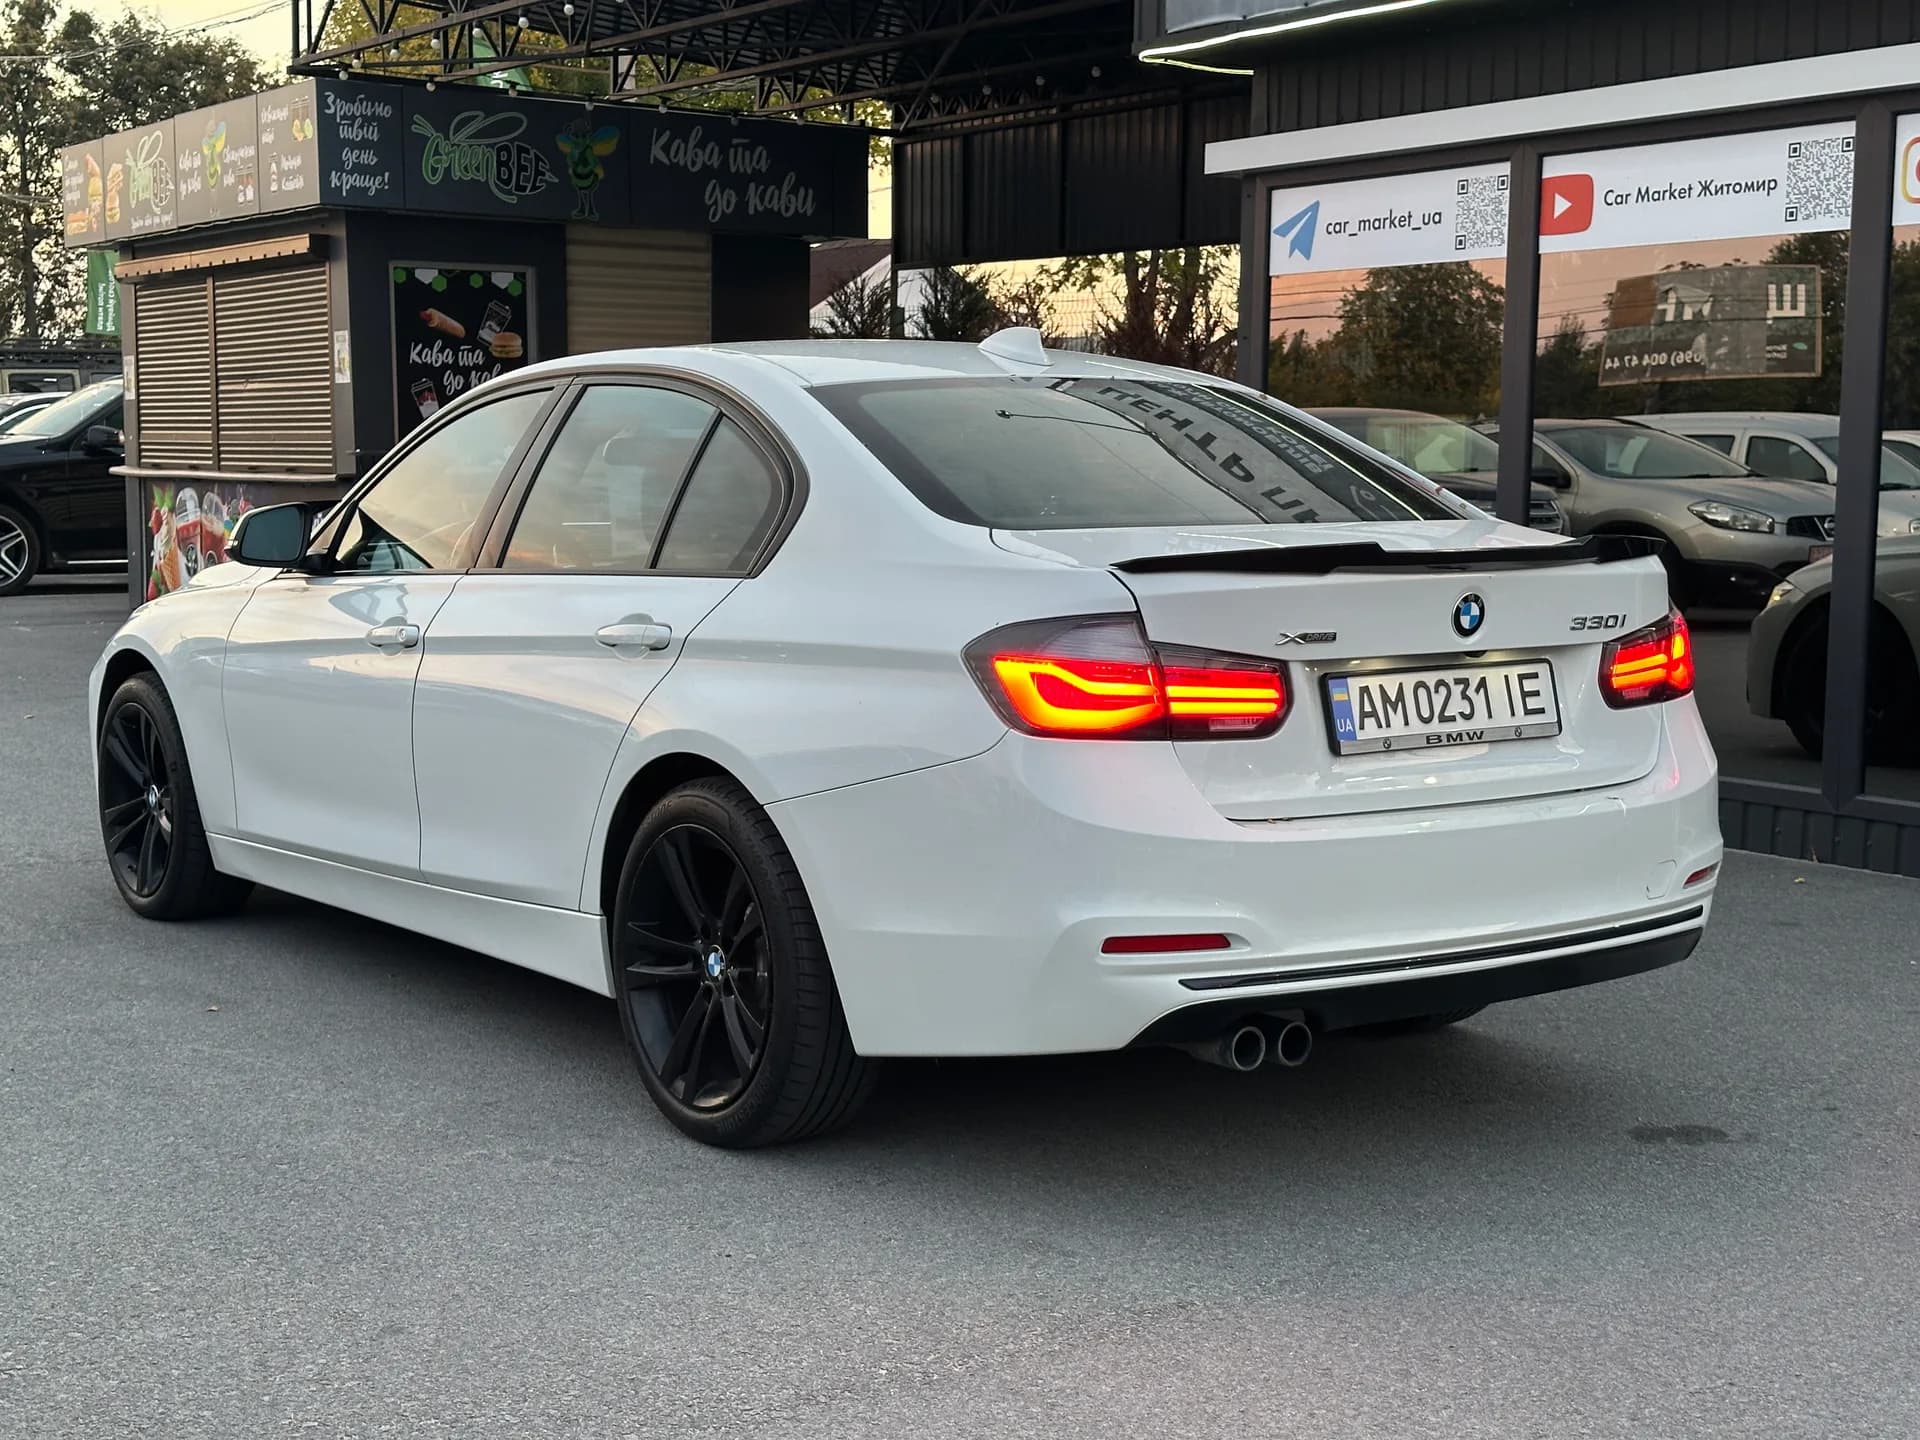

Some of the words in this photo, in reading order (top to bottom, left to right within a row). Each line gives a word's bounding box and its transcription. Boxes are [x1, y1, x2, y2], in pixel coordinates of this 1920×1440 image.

[324, 91, 393, 123] Зробимо
[339, 117, 379, 142] твій
[342, 147, 377, 170] день
[650, 125, 722, 172] Кава
[729, 138, 771, 173] та
[329, 170, 390, 197] краще!
[704, 179, 738, 222] до
[746, 171, 816, 217] кави
[1603, 189, 1631, 206] Car
[1635, 182, 1693, 203] Market
[1697, 178, 1778, 197] Житомир
[1326, 208, 1442, 237] car_market_ua
[409, 339, 455, 367] Кава
[457, 345, 486, 367] та
[443, 369, 465, 396] до
[1337, 719, 1354, 732] UA
[1425, 730, 1484, 745] BMW
